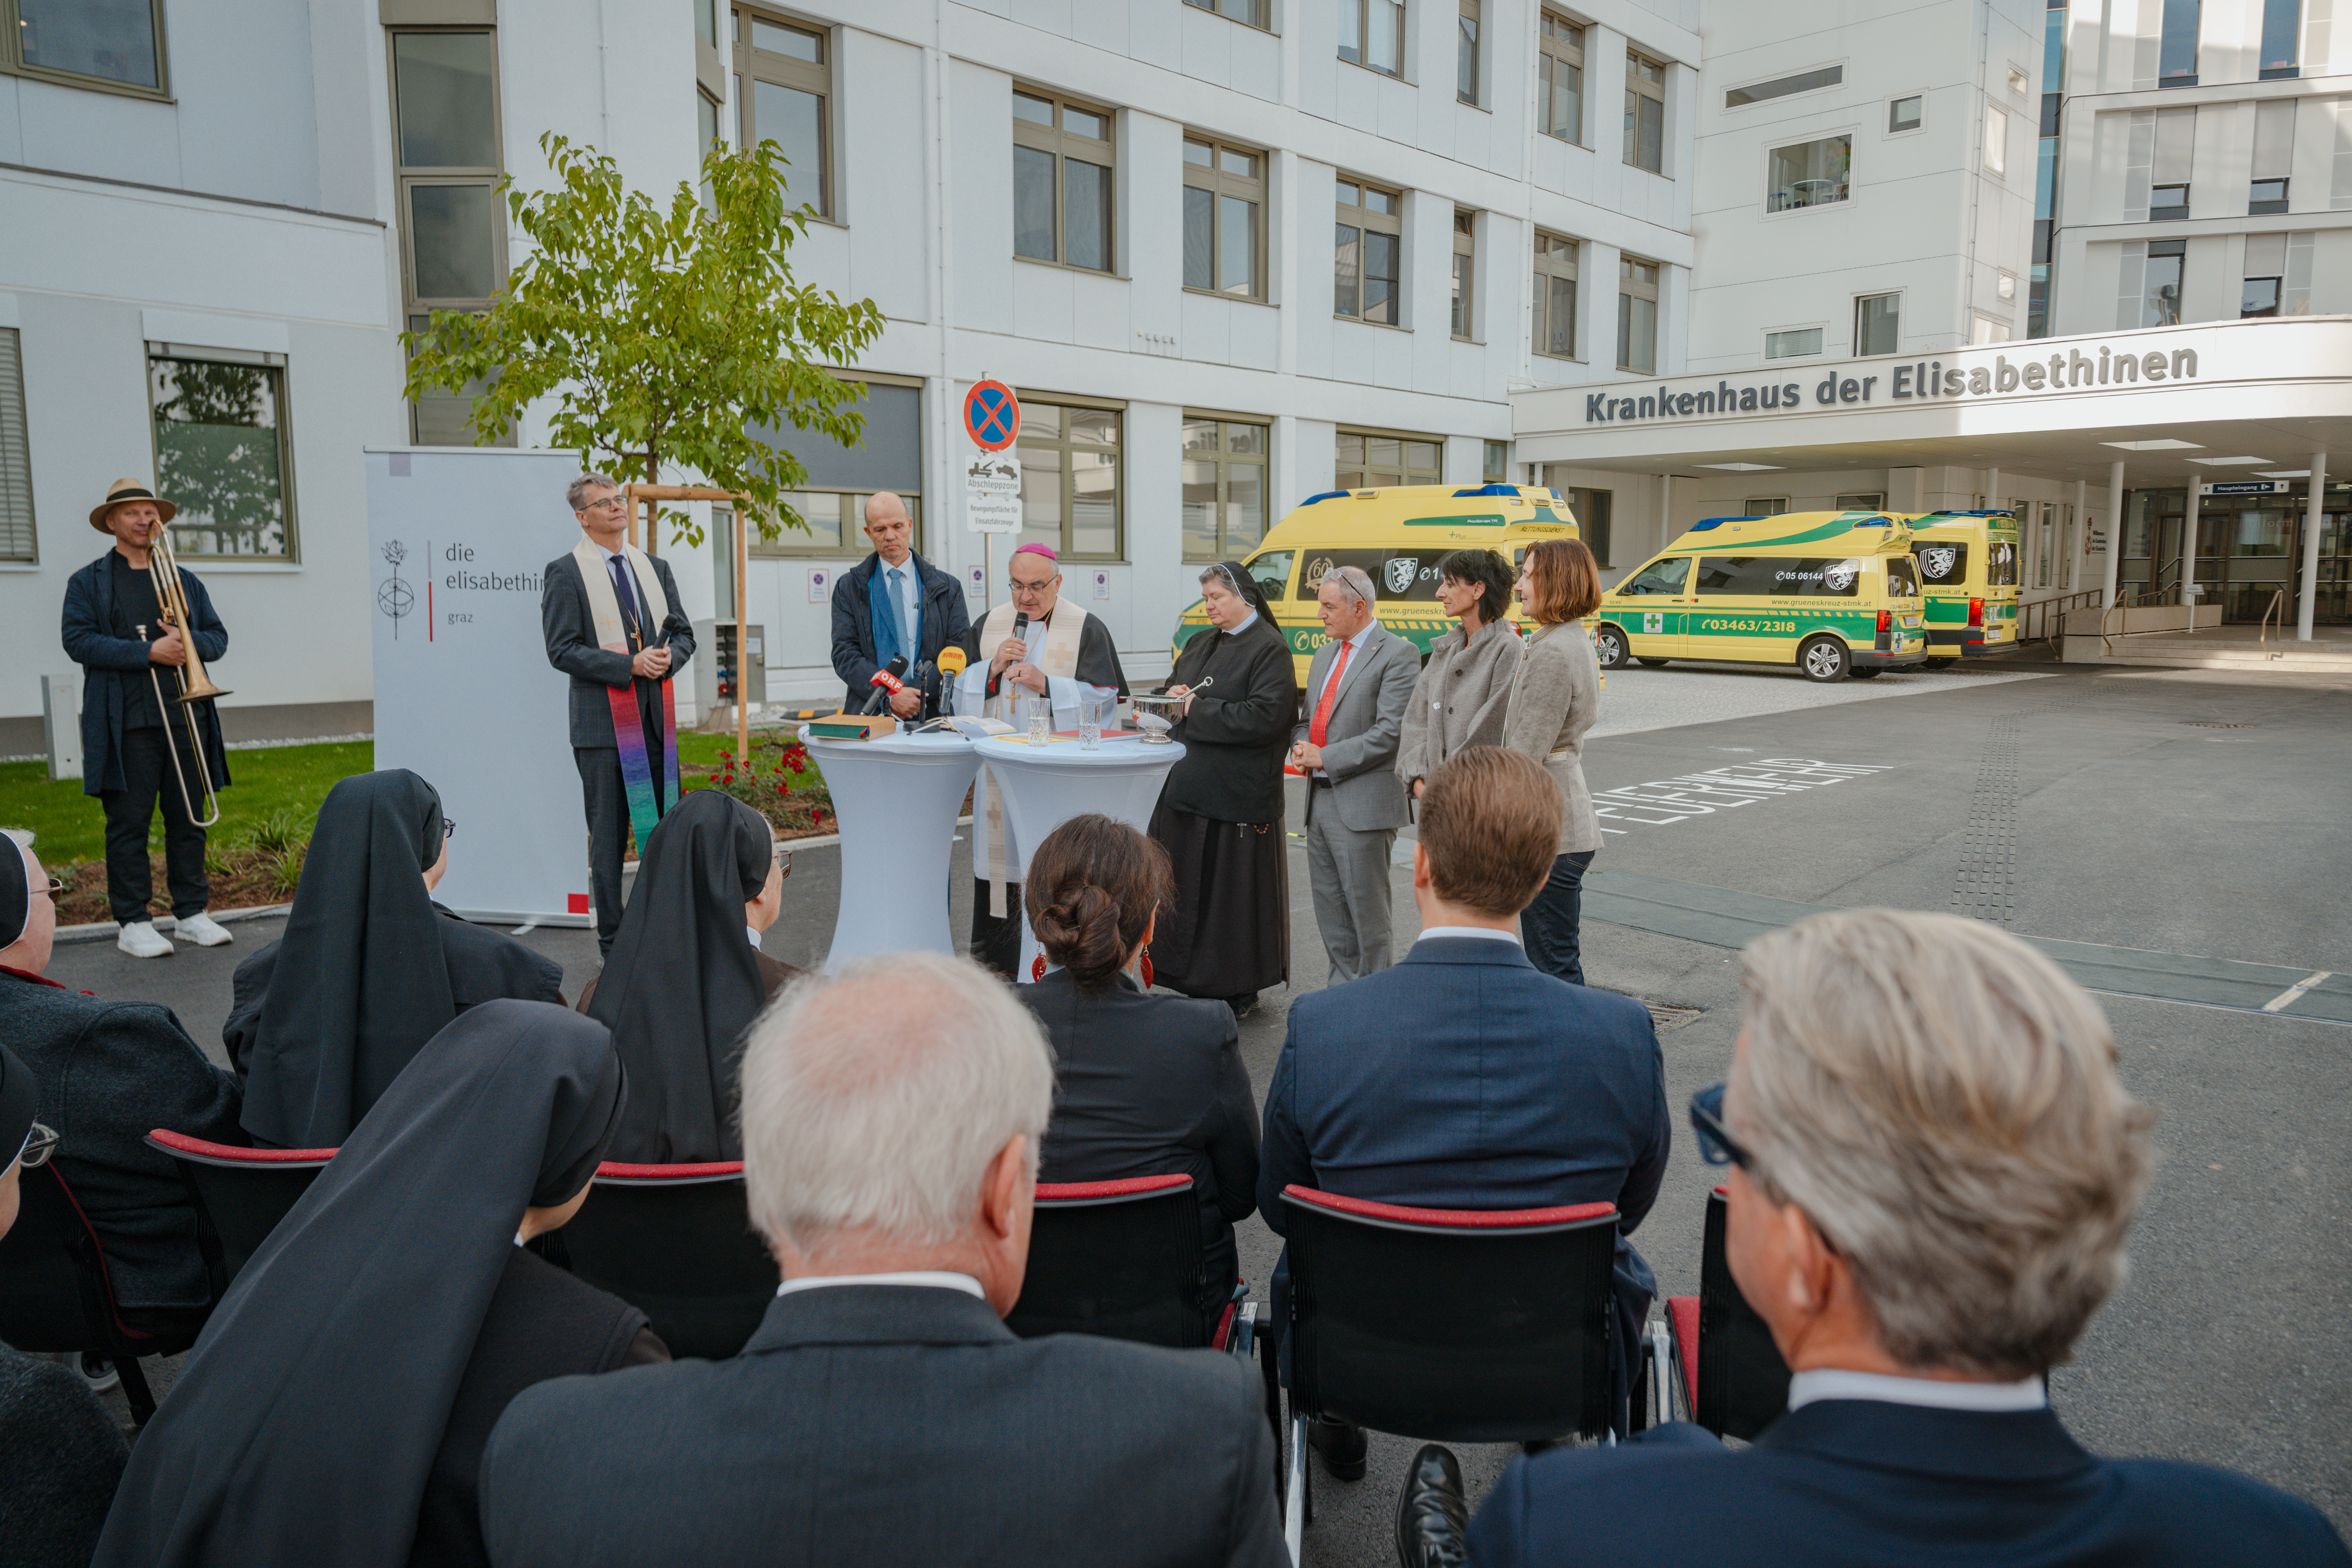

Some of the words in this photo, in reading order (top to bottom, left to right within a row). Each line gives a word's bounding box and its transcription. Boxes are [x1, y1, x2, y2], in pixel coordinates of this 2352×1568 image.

[1586, 380, 1800, 422] Krankenhaus
[1816, 371, 1877, 405] der
[1892, 345, 2198, 399] Elisabethinen
[968, 479, 1018, 490] Abschleppzone
[971, 505, 1010, 513] Bewegungsfläche
[975, 517, 1013, 526] Einsatzfahrzeuge
[446, 543, 474, 561] die
[1313, 562, 1329, 578] 60
[1785, 572, 1796, 580] 05
[448, 613, 473, 625] graz
[1710, 620, 1795, 632] 03463/2318
[881, 673, 902, 688] ORF
